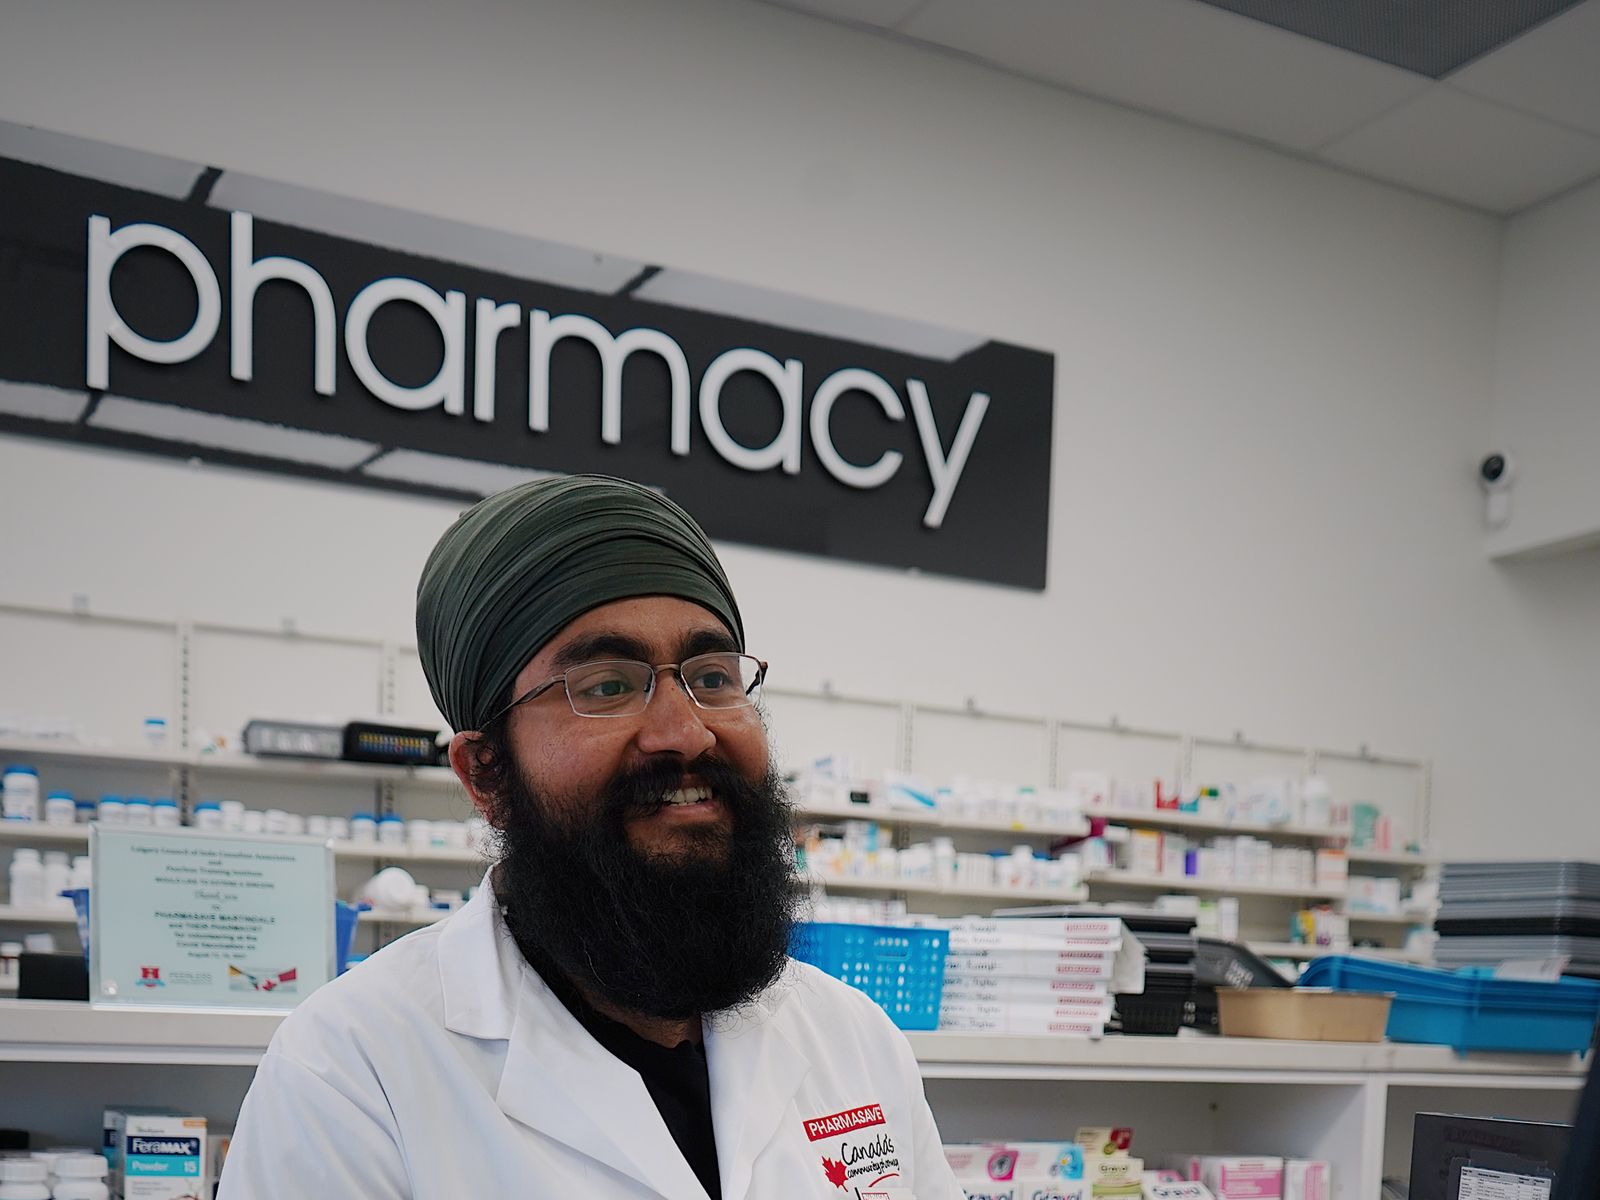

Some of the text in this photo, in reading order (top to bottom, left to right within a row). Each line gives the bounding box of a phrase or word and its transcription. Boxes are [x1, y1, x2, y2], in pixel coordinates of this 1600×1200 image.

[87, 211, 990, 528] pharmacy
[808, 1106, 882, 1137] PHARMASAVE
[841, 1133, 895, 1166] Canada's
[131, 1160, 198, 1173] Powder 15
